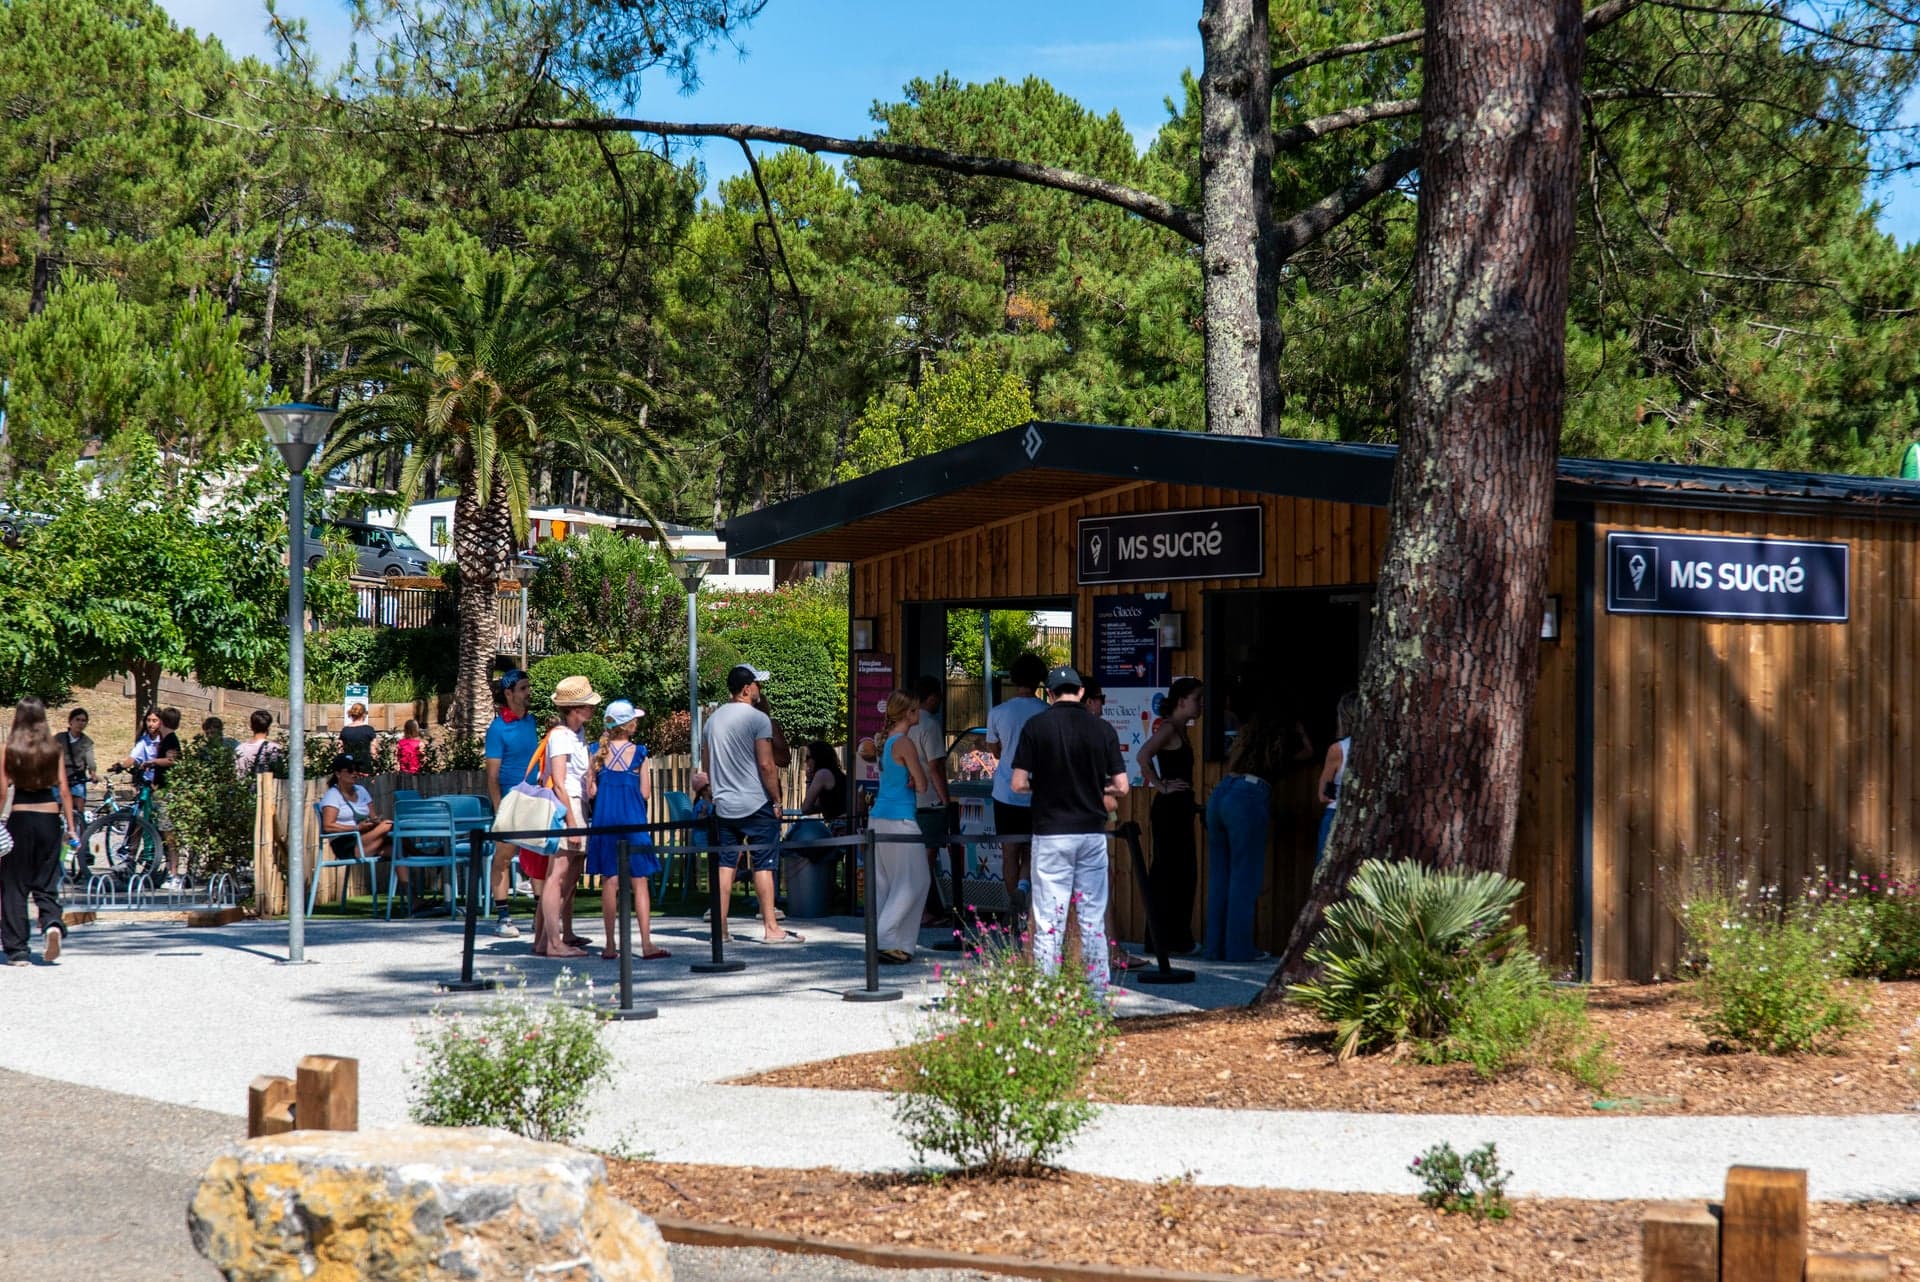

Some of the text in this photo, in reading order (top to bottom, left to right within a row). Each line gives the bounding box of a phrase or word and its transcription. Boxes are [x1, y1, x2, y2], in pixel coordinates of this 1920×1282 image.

[1118, 521, 1222, 560] MS SUCRé
[1670, 556, 1805, 593] MS SUCRé
